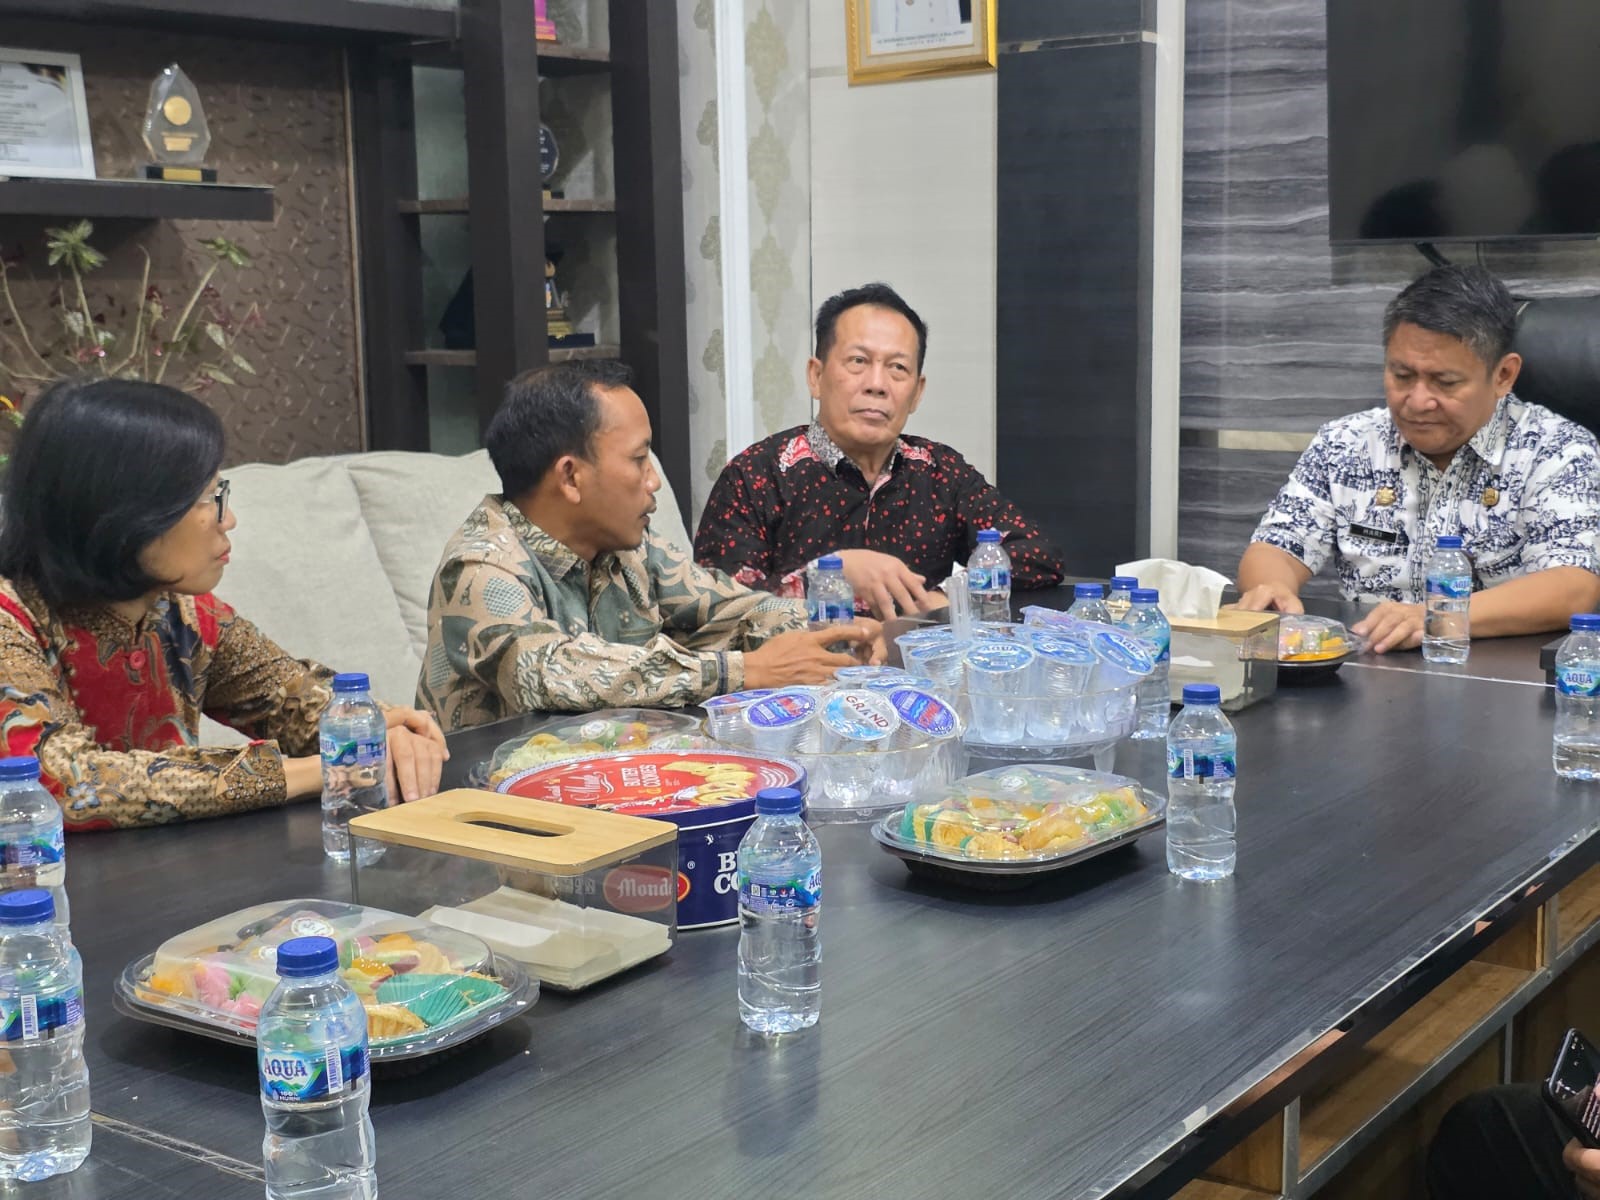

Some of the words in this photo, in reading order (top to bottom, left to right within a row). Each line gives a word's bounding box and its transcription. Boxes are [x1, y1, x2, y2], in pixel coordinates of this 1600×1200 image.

[1565, 672, 1593, 686] AQUA
[846, 696, 889, 727] GRAND
[264, 1057, 307, 1080] AQUA
